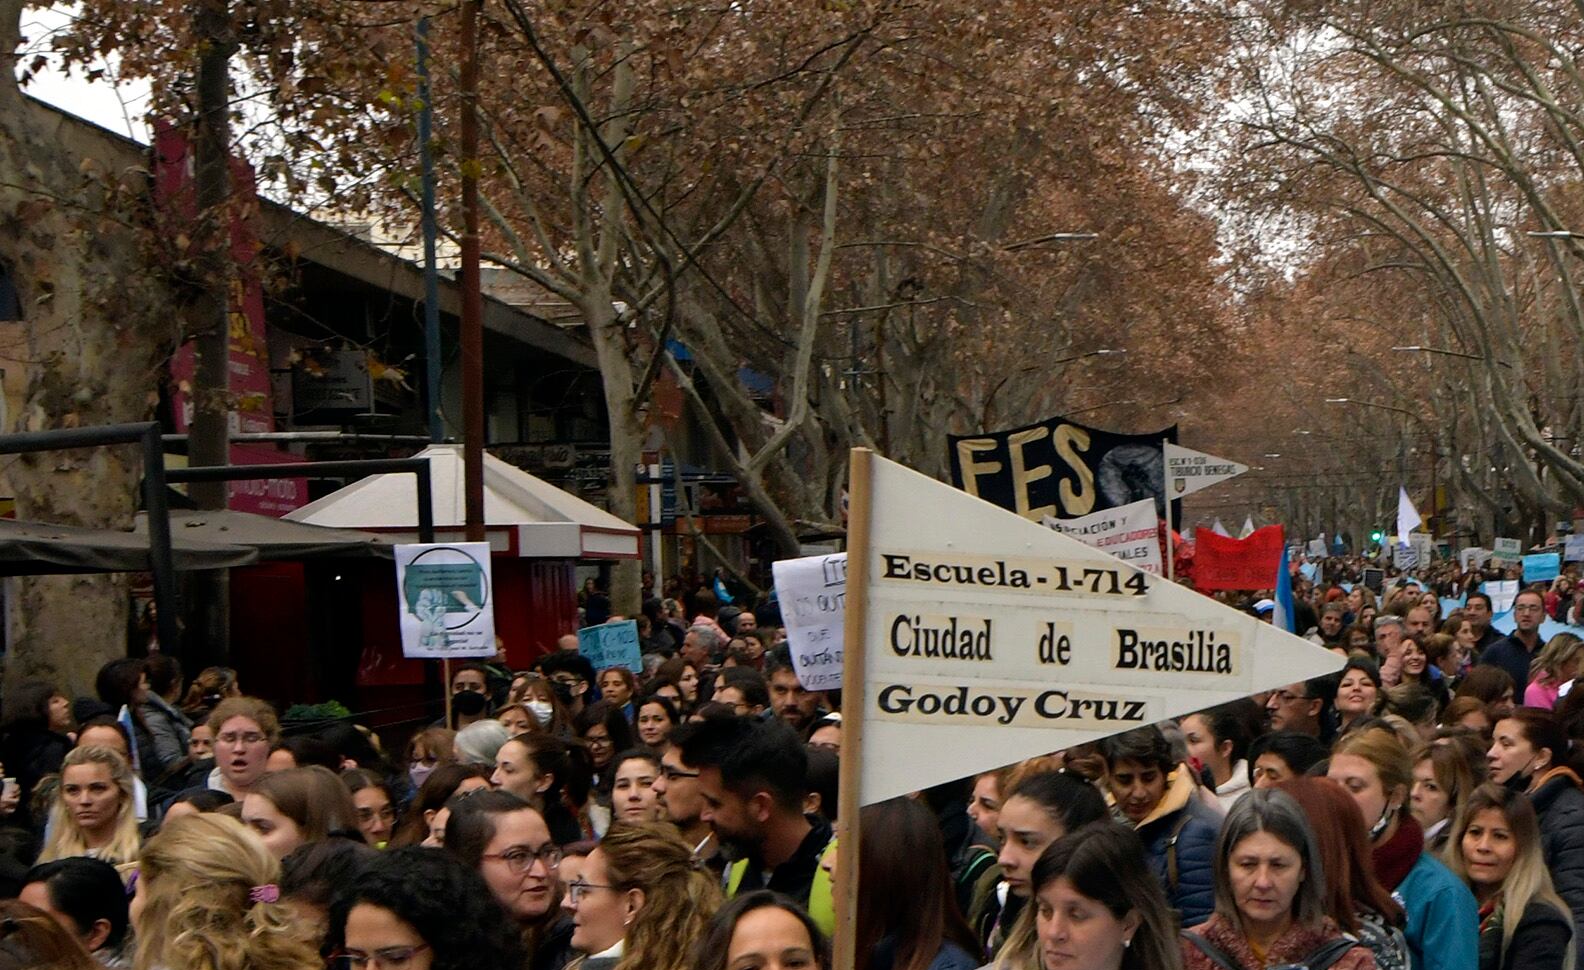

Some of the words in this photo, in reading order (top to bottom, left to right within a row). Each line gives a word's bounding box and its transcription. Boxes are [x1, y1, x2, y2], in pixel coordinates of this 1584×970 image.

[956, 424, 1096, 523] FES
[1121, 516, 1129, 526] Y
[880, 553, 1031, 589] Escuela
[1054, 566, 1150, 596] 1-714
[890, 614, 993, 661] Ciudad
[1038, 621, 1072, 665] de
[1115, 629, 1232, 675] Brasilia
[877, 684, 1028, 726] Godoy
[1033, 690, 1147, 722] Cruz
